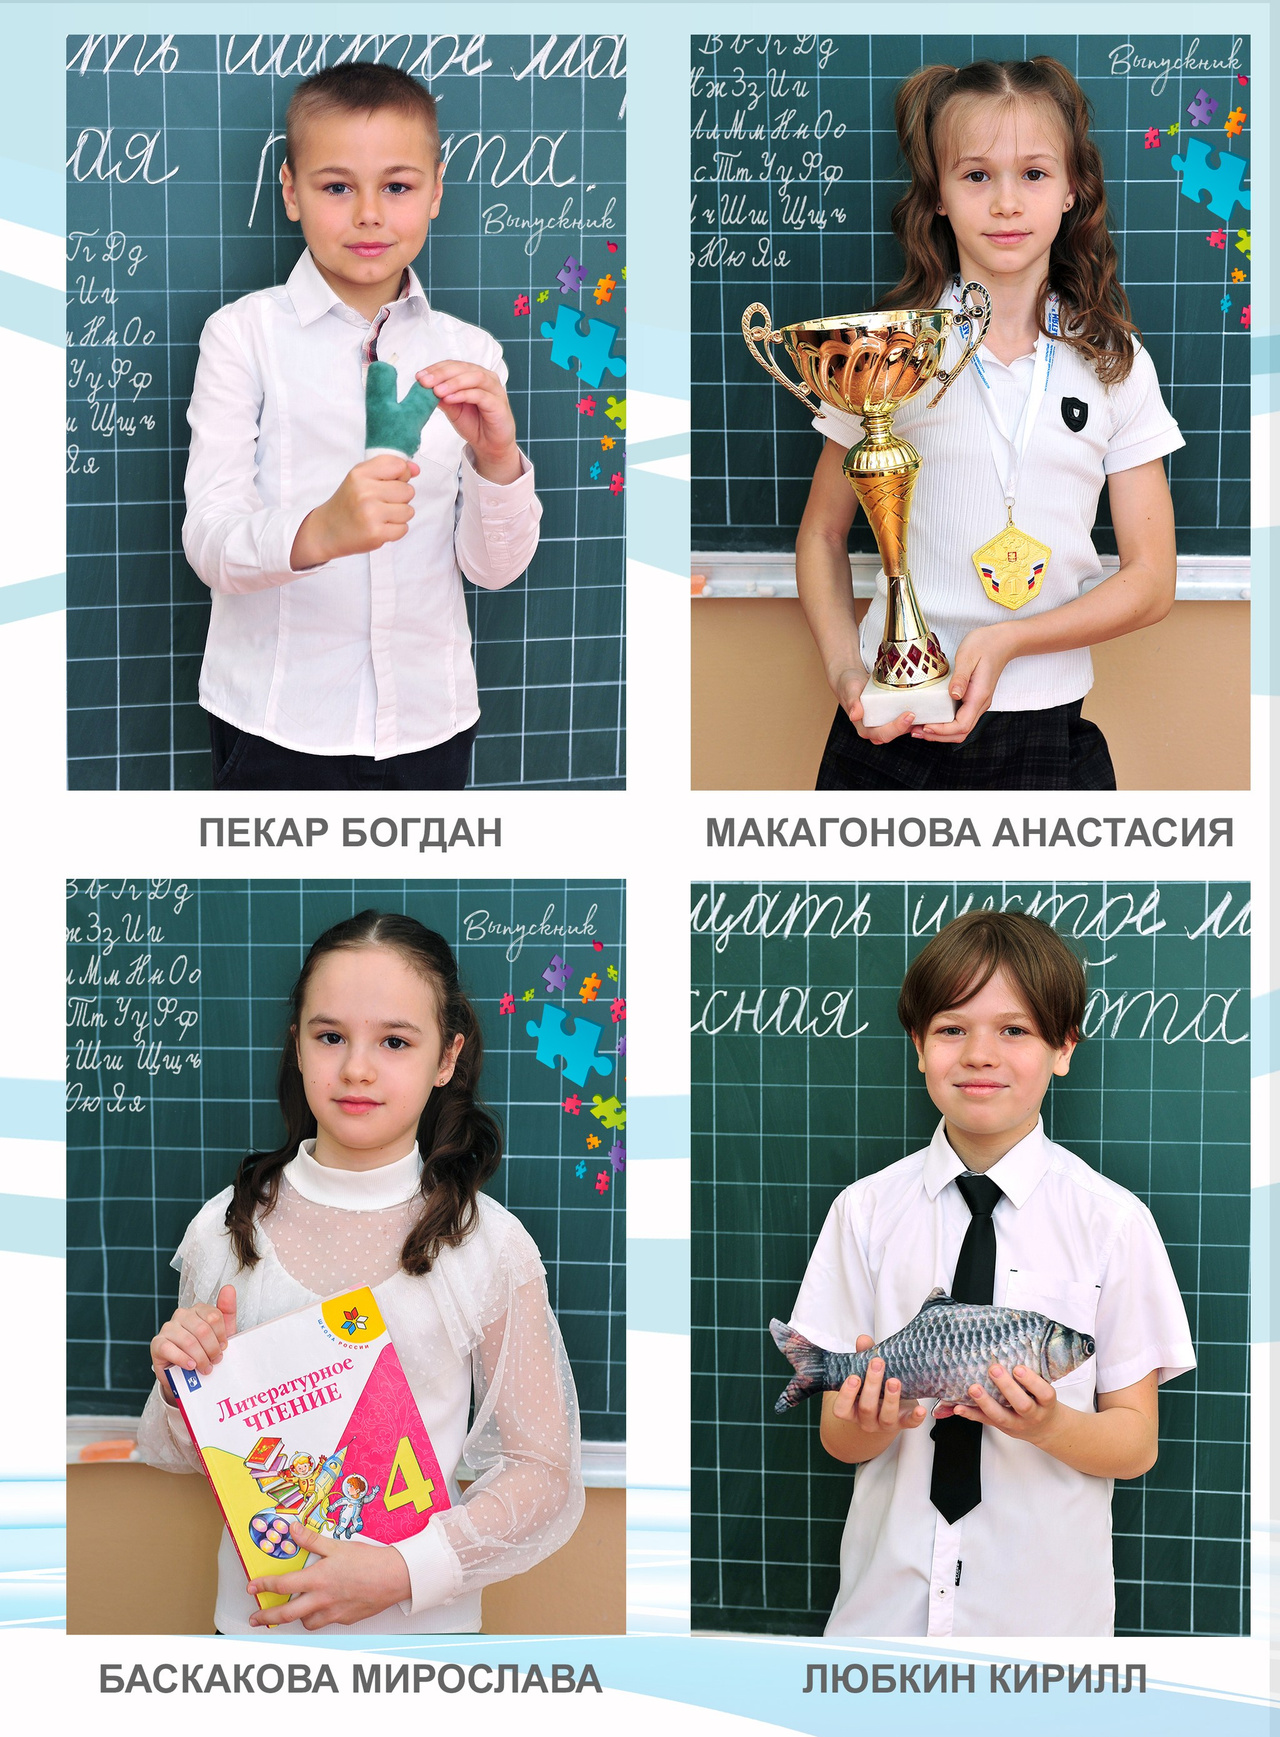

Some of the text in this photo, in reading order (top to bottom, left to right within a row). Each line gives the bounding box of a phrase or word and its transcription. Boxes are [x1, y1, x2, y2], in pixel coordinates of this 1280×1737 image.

[1109, 37, 1243, 96] Выпускник
[482, 197, 617, 255] Выпускник
[464, 903, 597, 961] Выпускник
[317, 1318, 370, 1350] ШКОЛА РОССИИ
[215, 1357, 354, 1422] Литературное
[242, 1382, 342, 1432] ЧТЕНИЕ
[383, 1435, 435, 1514] 4
